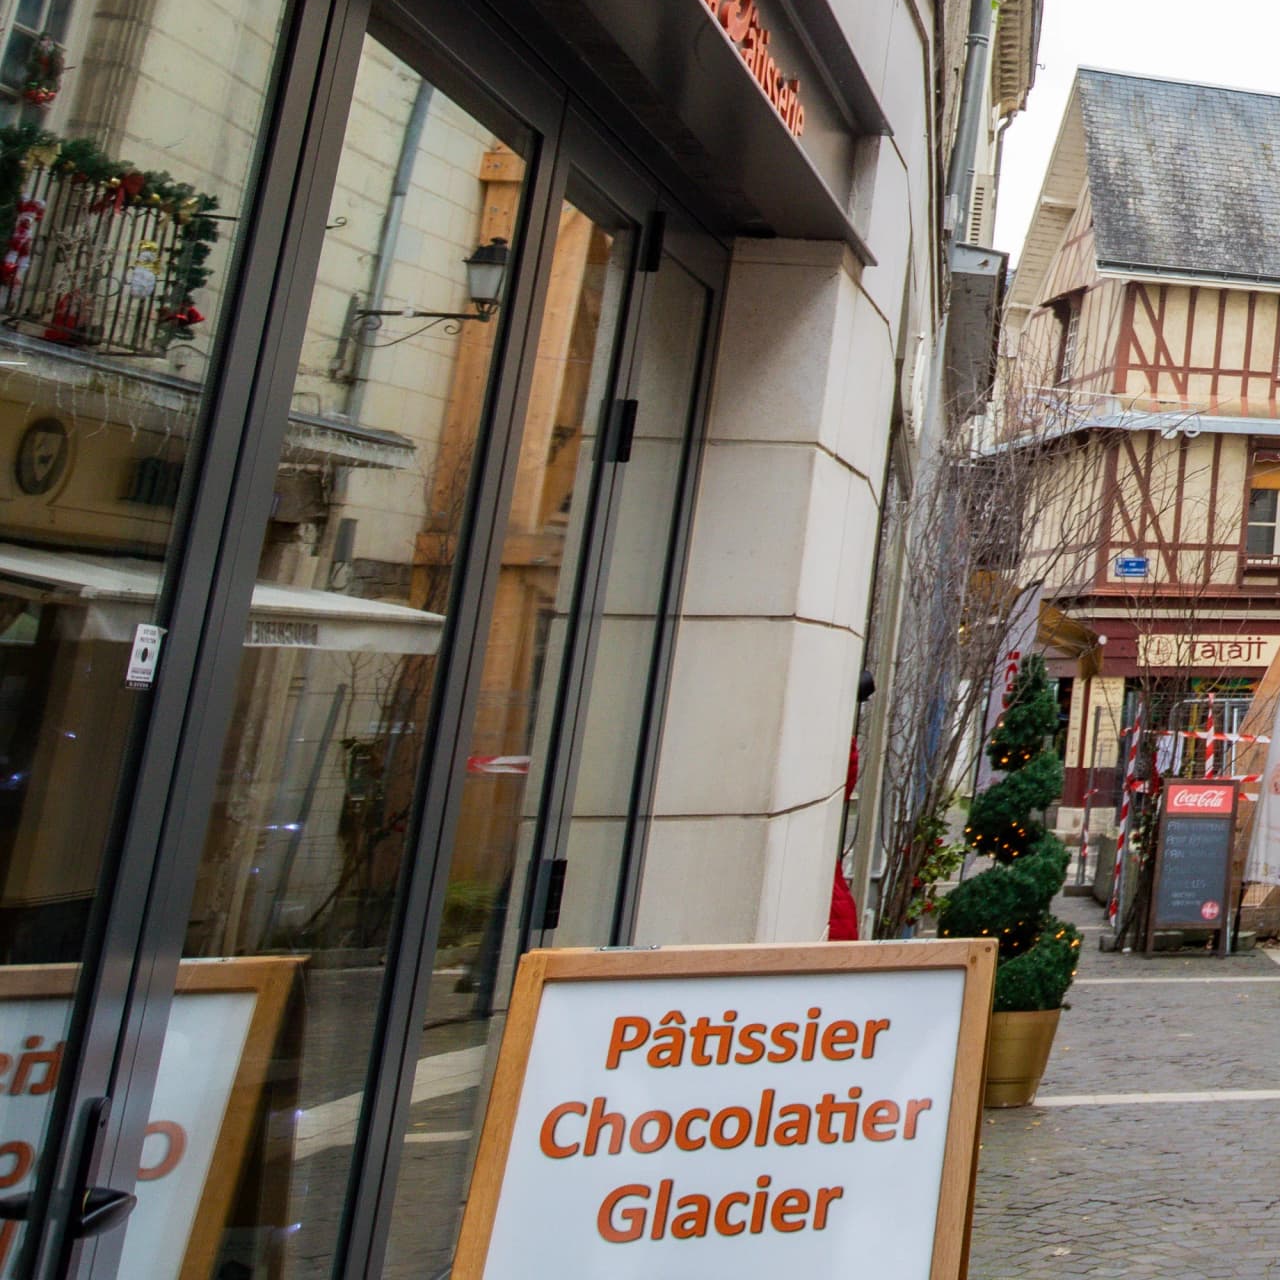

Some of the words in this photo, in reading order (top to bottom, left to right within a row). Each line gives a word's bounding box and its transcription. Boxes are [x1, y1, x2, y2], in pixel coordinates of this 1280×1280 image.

[1173, 789, 1226, 808] Coca-Cola
[605, 1006, 890, 1070] Pâtissier
[539, 1086, 932, 1160] Chocolatier
[596, 1175, 843, 1244] Glacier
